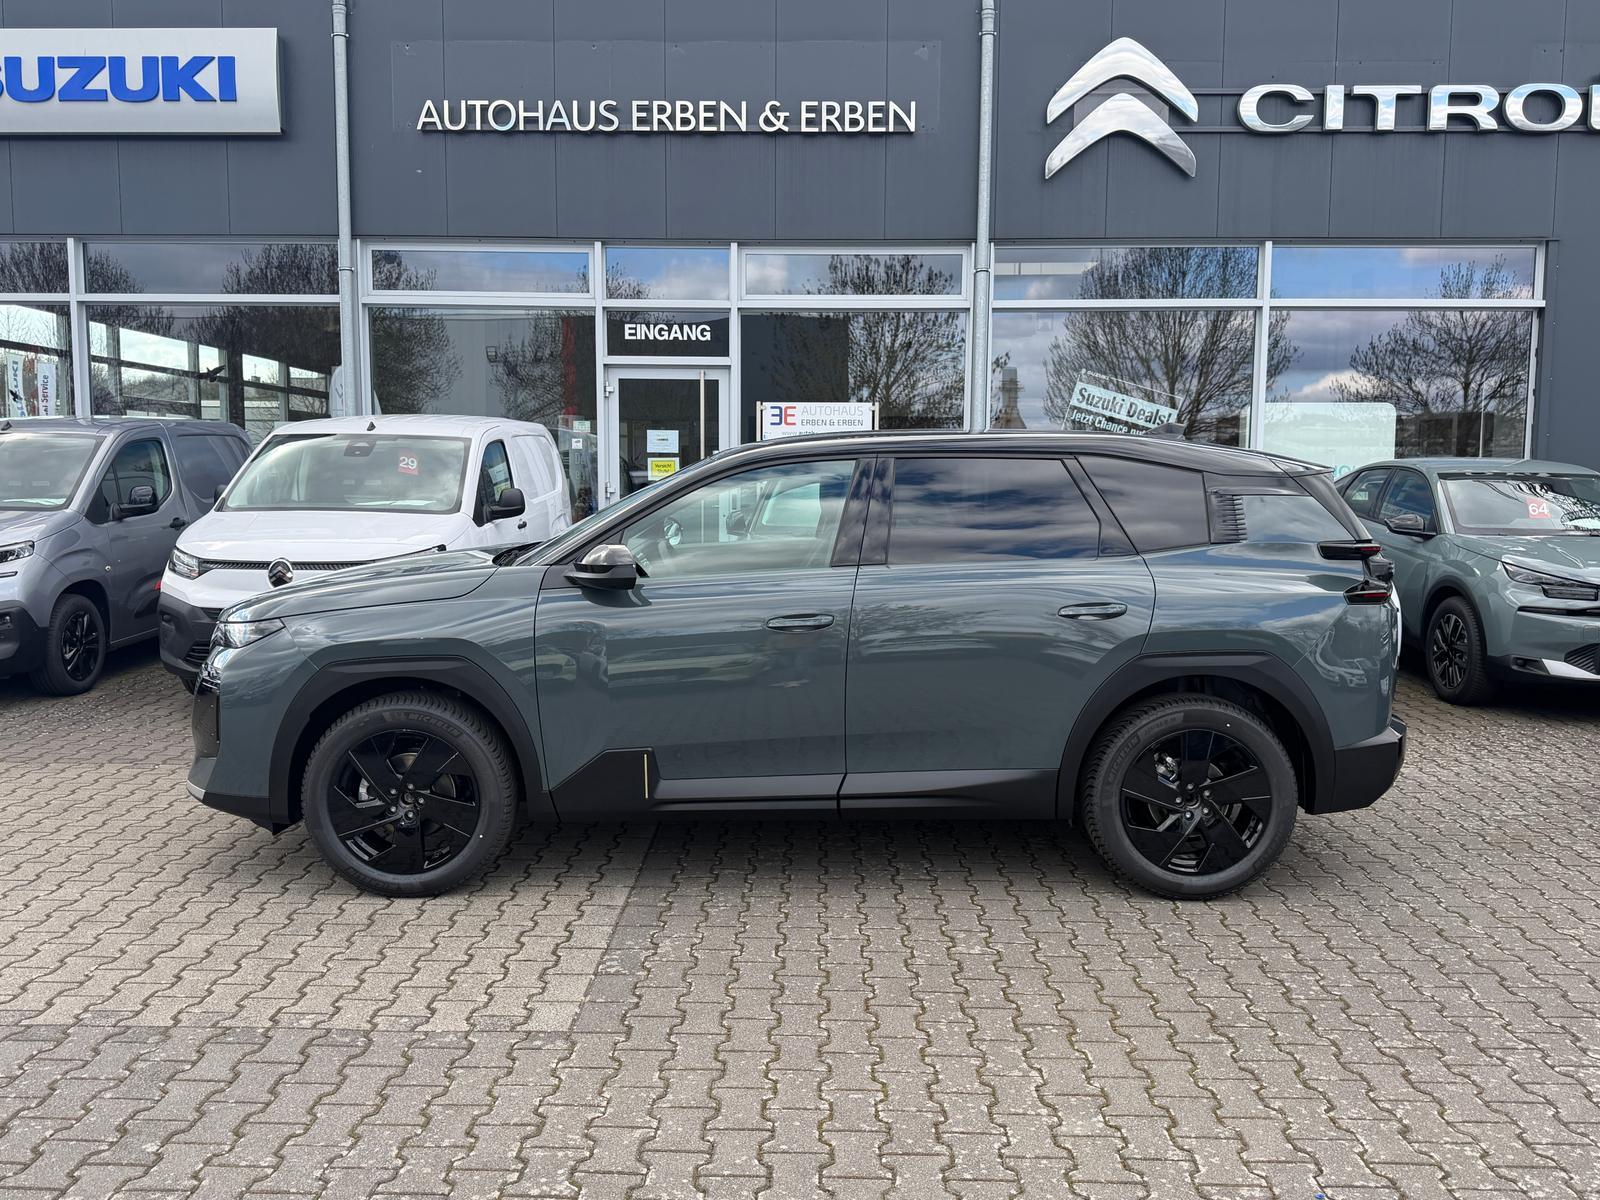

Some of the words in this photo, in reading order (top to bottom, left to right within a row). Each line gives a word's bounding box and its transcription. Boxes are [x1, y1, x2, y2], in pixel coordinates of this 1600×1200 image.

[0, 56, 237, 102] UZUKI
[416, 100, 619, 131] AUTOHAUS
[631, 100, 747, 131] ERBEN
[759, 100, 790, 132] &
[801, 101, 916, 132] ERBEN
[1237, 83, 1600, 132] CITRO
[624, 323, 711, 341] EINGANG
[41, 374, 49, 403] Service
[1077, 387, 1125, 415] Suzuki
[801, 405, 864, 416] AUTOHAUS
[1071, 409, 1094, 426] Jetzt
[1094, 416, 1128, 434] Chance
[399, 456, 417, 470] 29
[1528, 502, 1549, 515] 64
